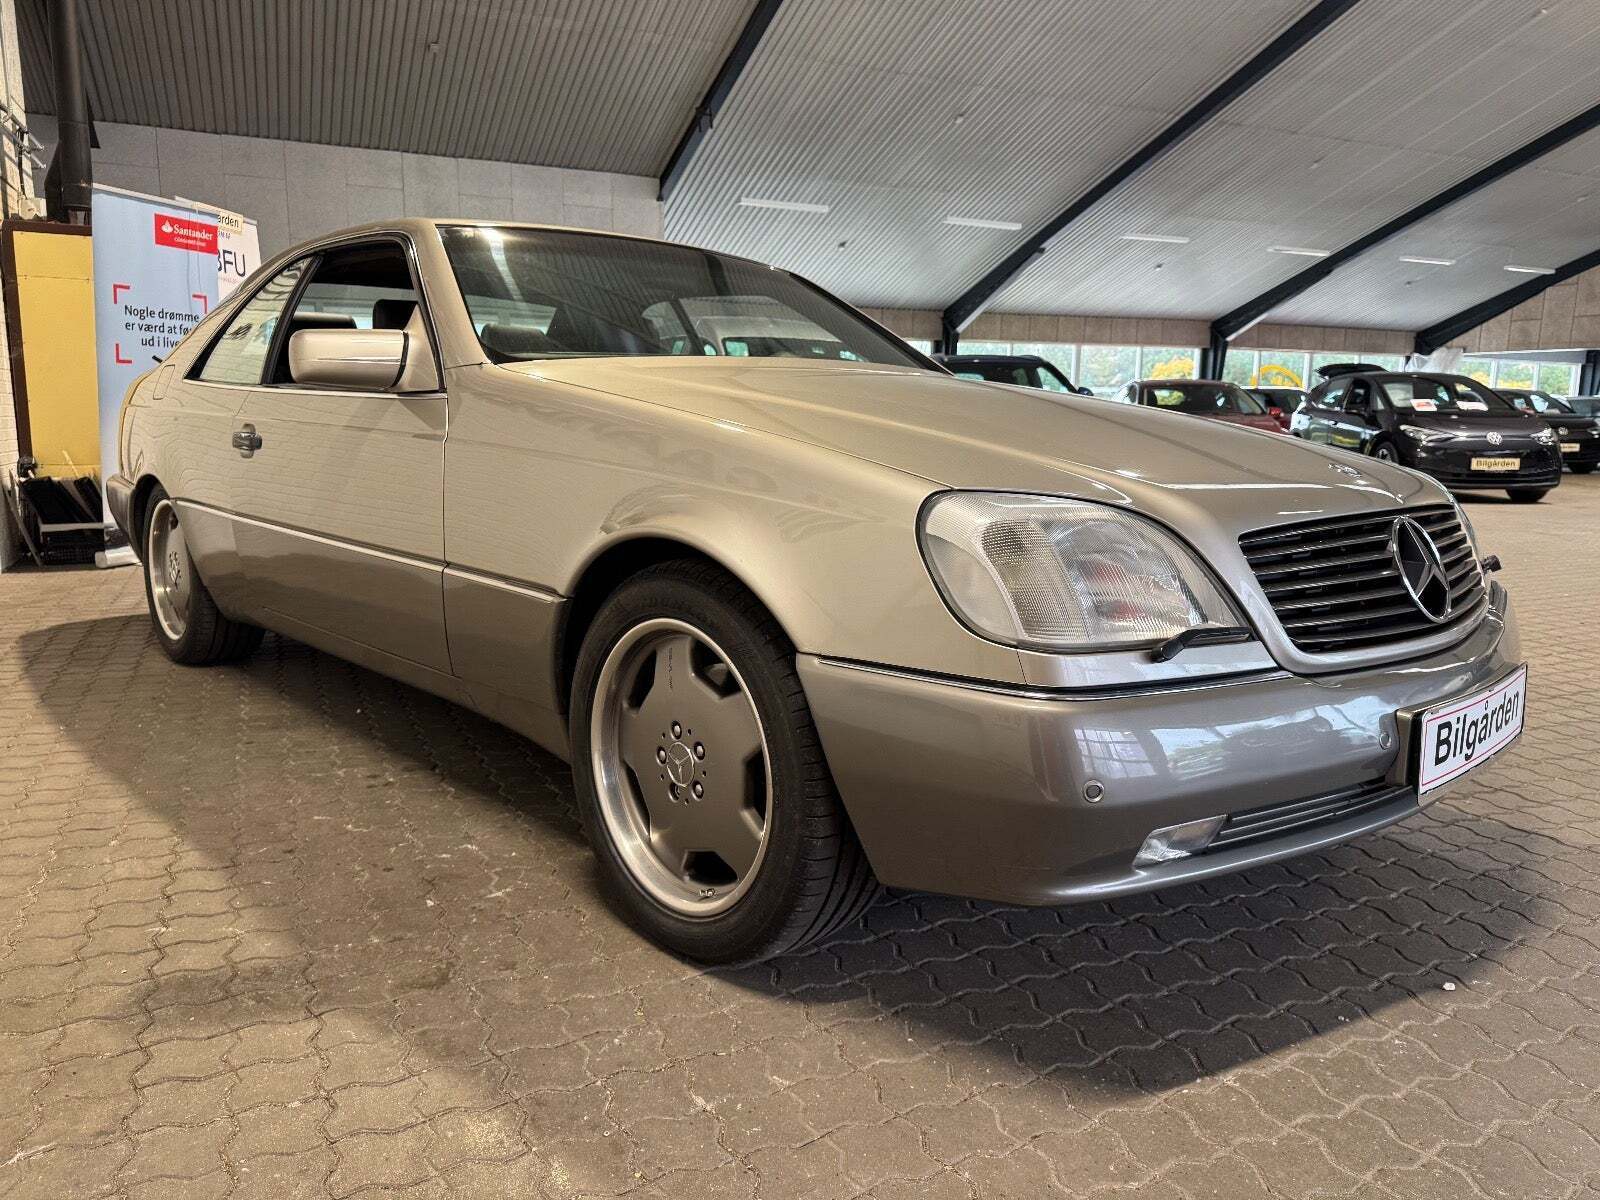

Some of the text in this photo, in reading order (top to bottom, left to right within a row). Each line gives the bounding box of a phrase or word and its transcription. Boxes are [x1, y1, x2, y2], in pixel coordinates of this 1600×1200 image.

[173, 223, 214, 241] Santander
[124, 304, 200, 323] Nogle drømme
[125, 321, 136, 331] er
[138, 322, 165, 333] værd
[167, 324, 177, 334] at
[141, 335, 154, 347] ud
[157, 336, 161, 347] i
[1434, 690, 1520, 766] Bilgården
